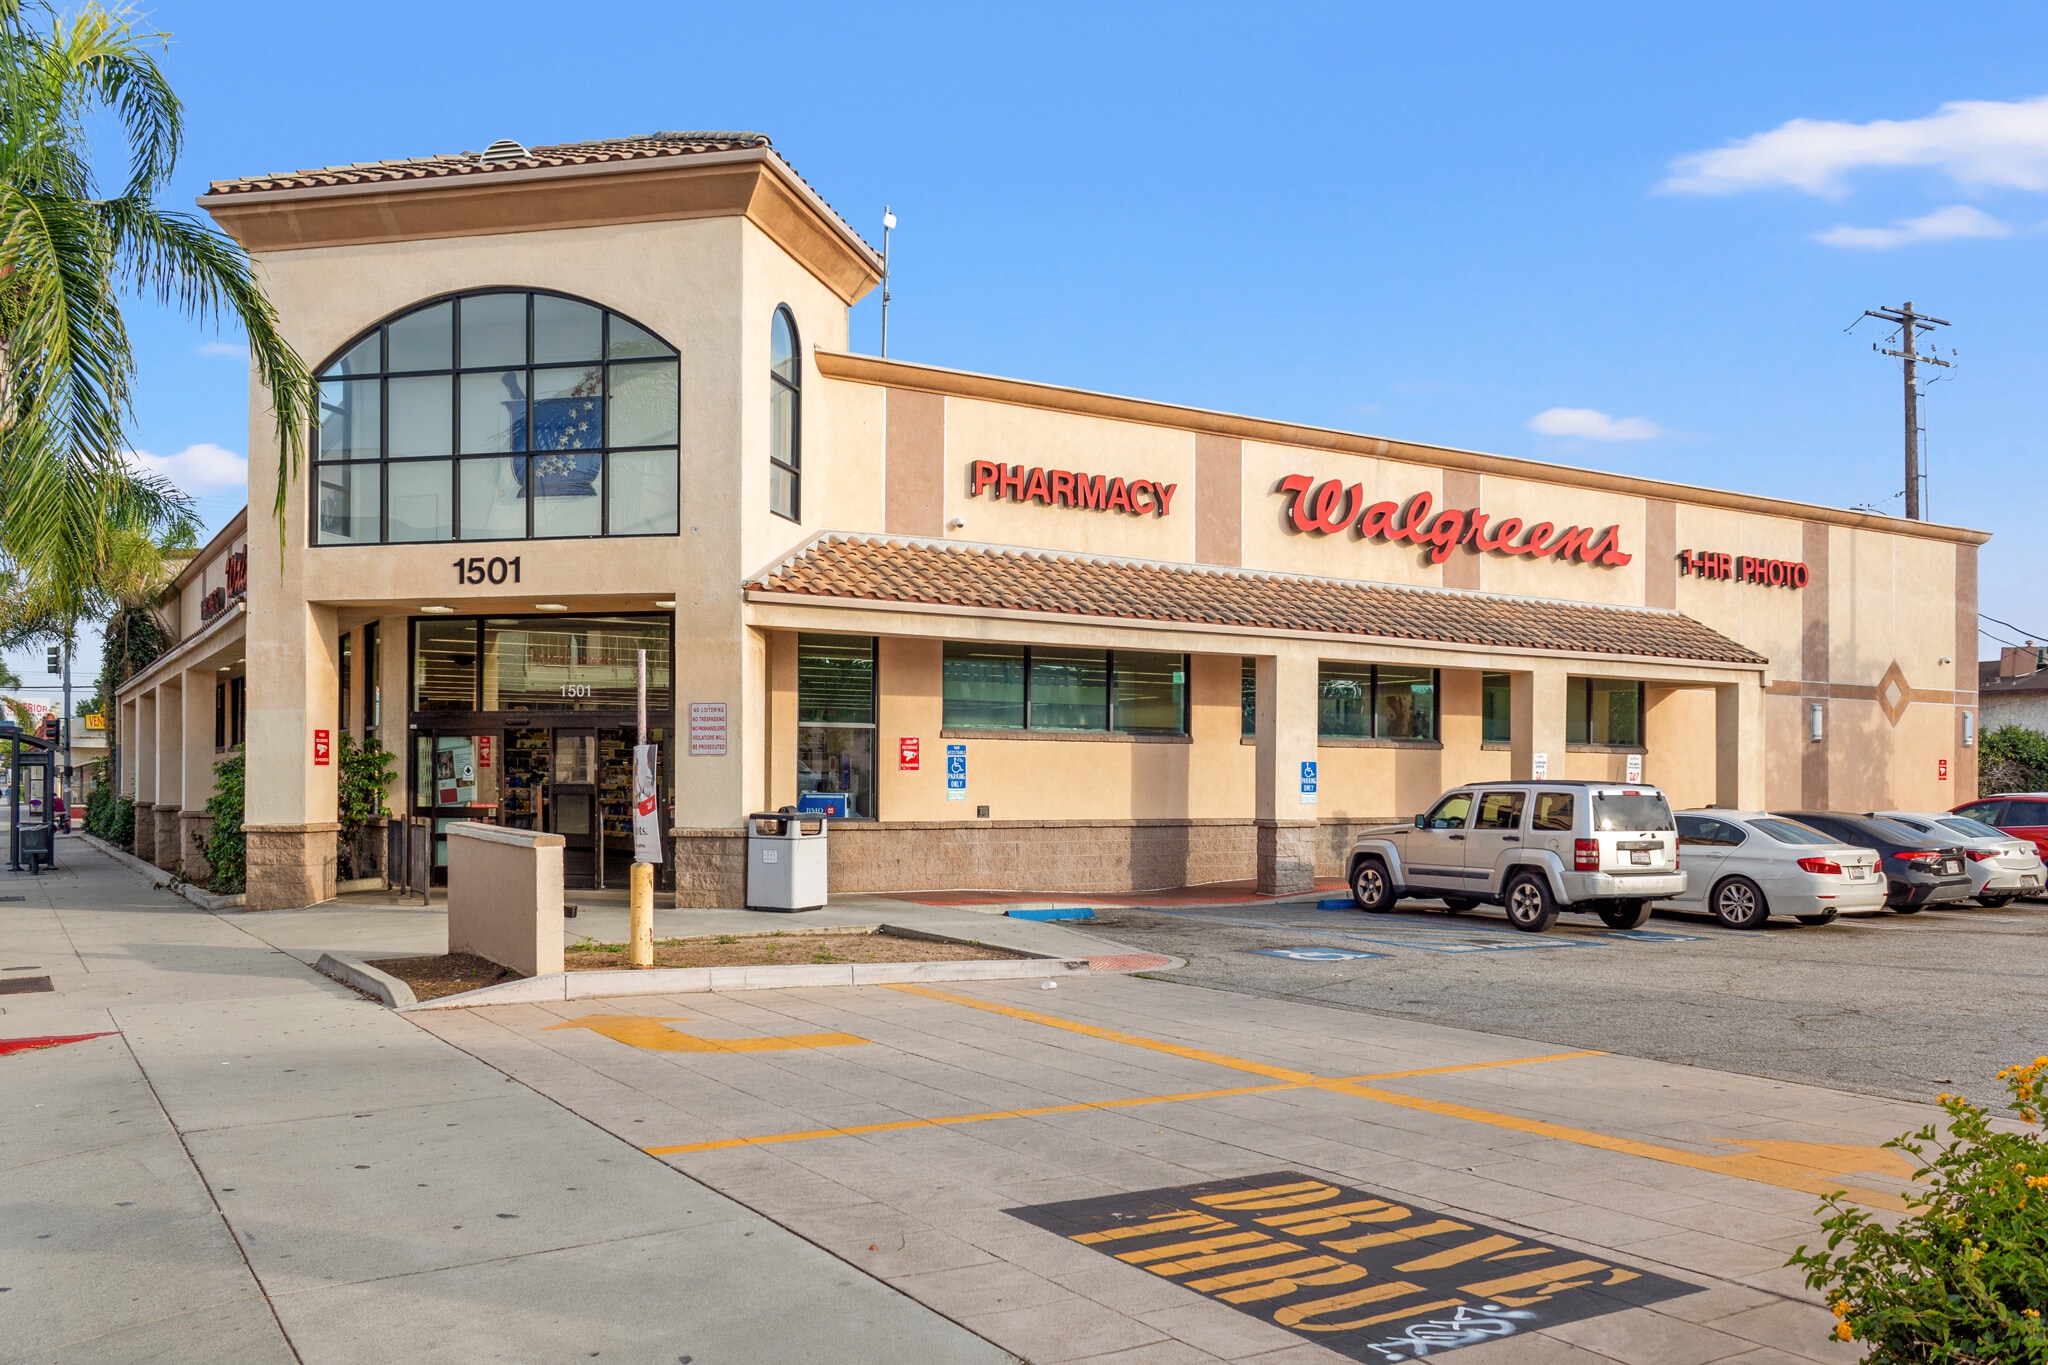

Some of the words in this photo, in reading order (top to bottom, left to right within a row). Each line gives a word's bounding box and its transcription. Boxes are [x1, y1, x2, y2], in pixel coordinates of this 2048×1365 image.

[971, 459, 1178, 517] PHARMACY
[1278, 473, 1633, 566] Walgreens
[452, 556, 521, 585] 1501
[1679, 548, 1733, 580] 1-HR
[1736, 555, 1809, 589] PHOTO
[7, 702, 48, 713] SERIOR
[560, 684, 591, 697] 1501
[88, 716, 106, 727] VEN
[951, 780, 963, 788] ONLY
[1190, 1180, 1643, 1308] DRIVE
[1068, 1209, 1468, 1332] THRU
